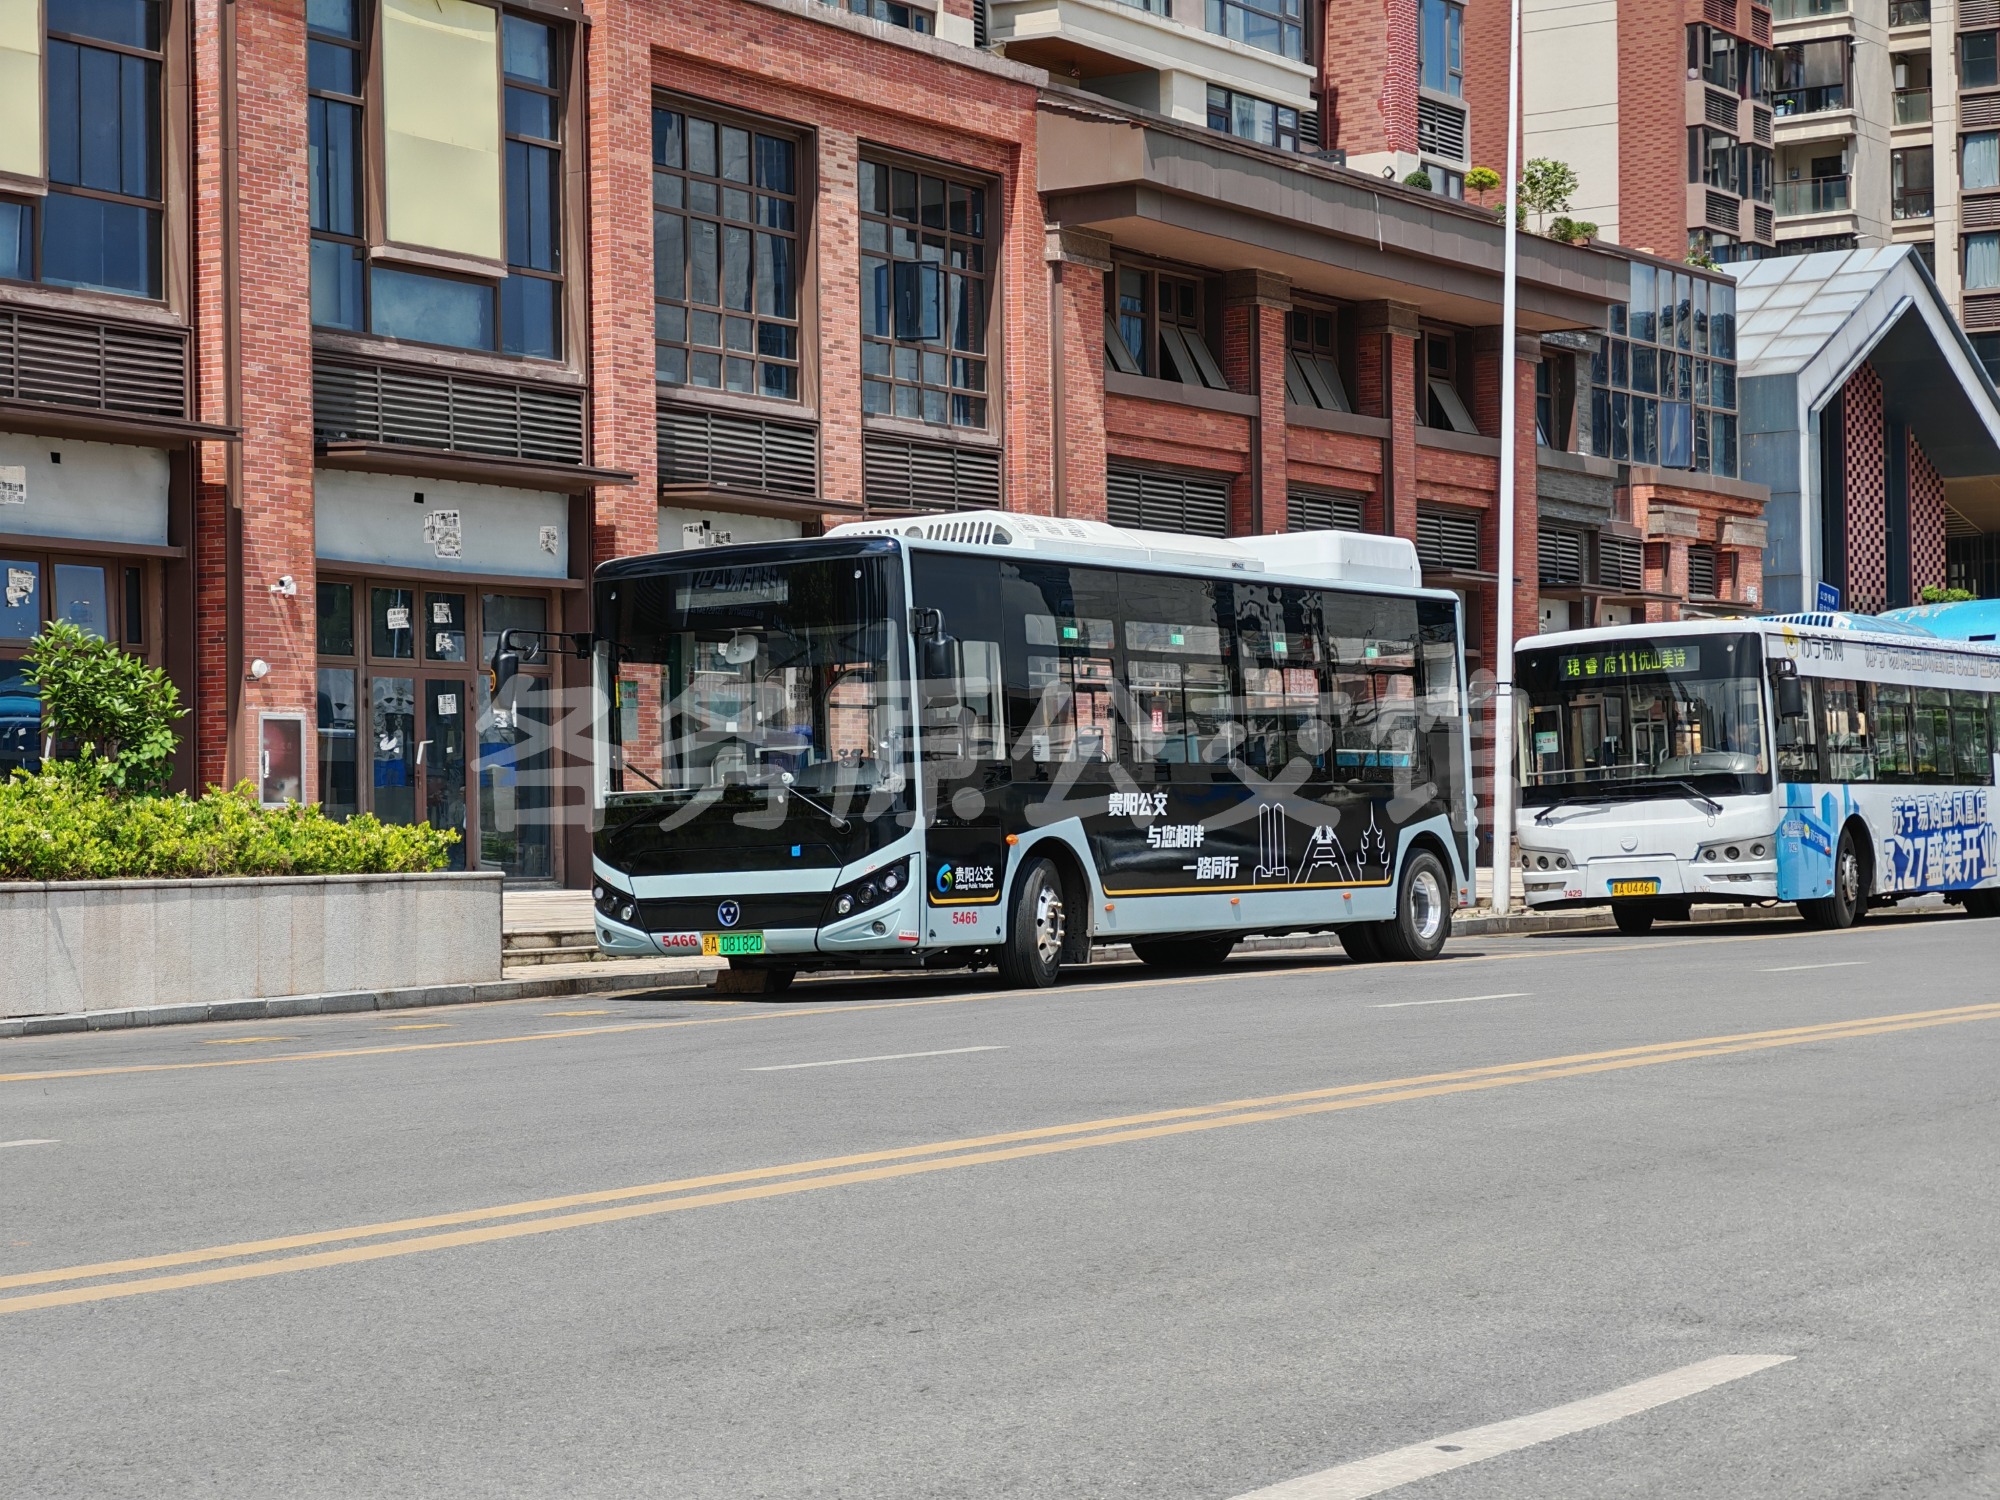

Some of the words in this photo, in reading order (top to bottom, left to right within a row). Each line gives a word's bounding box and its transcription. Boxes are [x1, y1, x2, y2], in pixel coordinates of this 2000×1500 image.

[1108, 792, 1168, 816] 贵阳公交
[1891, 788, 1989, 835] 苏宁易购金凤凰店
[1146, 825, 1205, 848] 与您相伴
[1182, 856, 1239, 880] 一路同行
[1884, 823, 1999, 892] 3.27盛装开业
[955, 866, 994, 882] 贵阳公交
[1563, 889, 1583, 898] 7429
[952, 911, 978, 925] 5466
[662, 934, 698, 948] 5466
